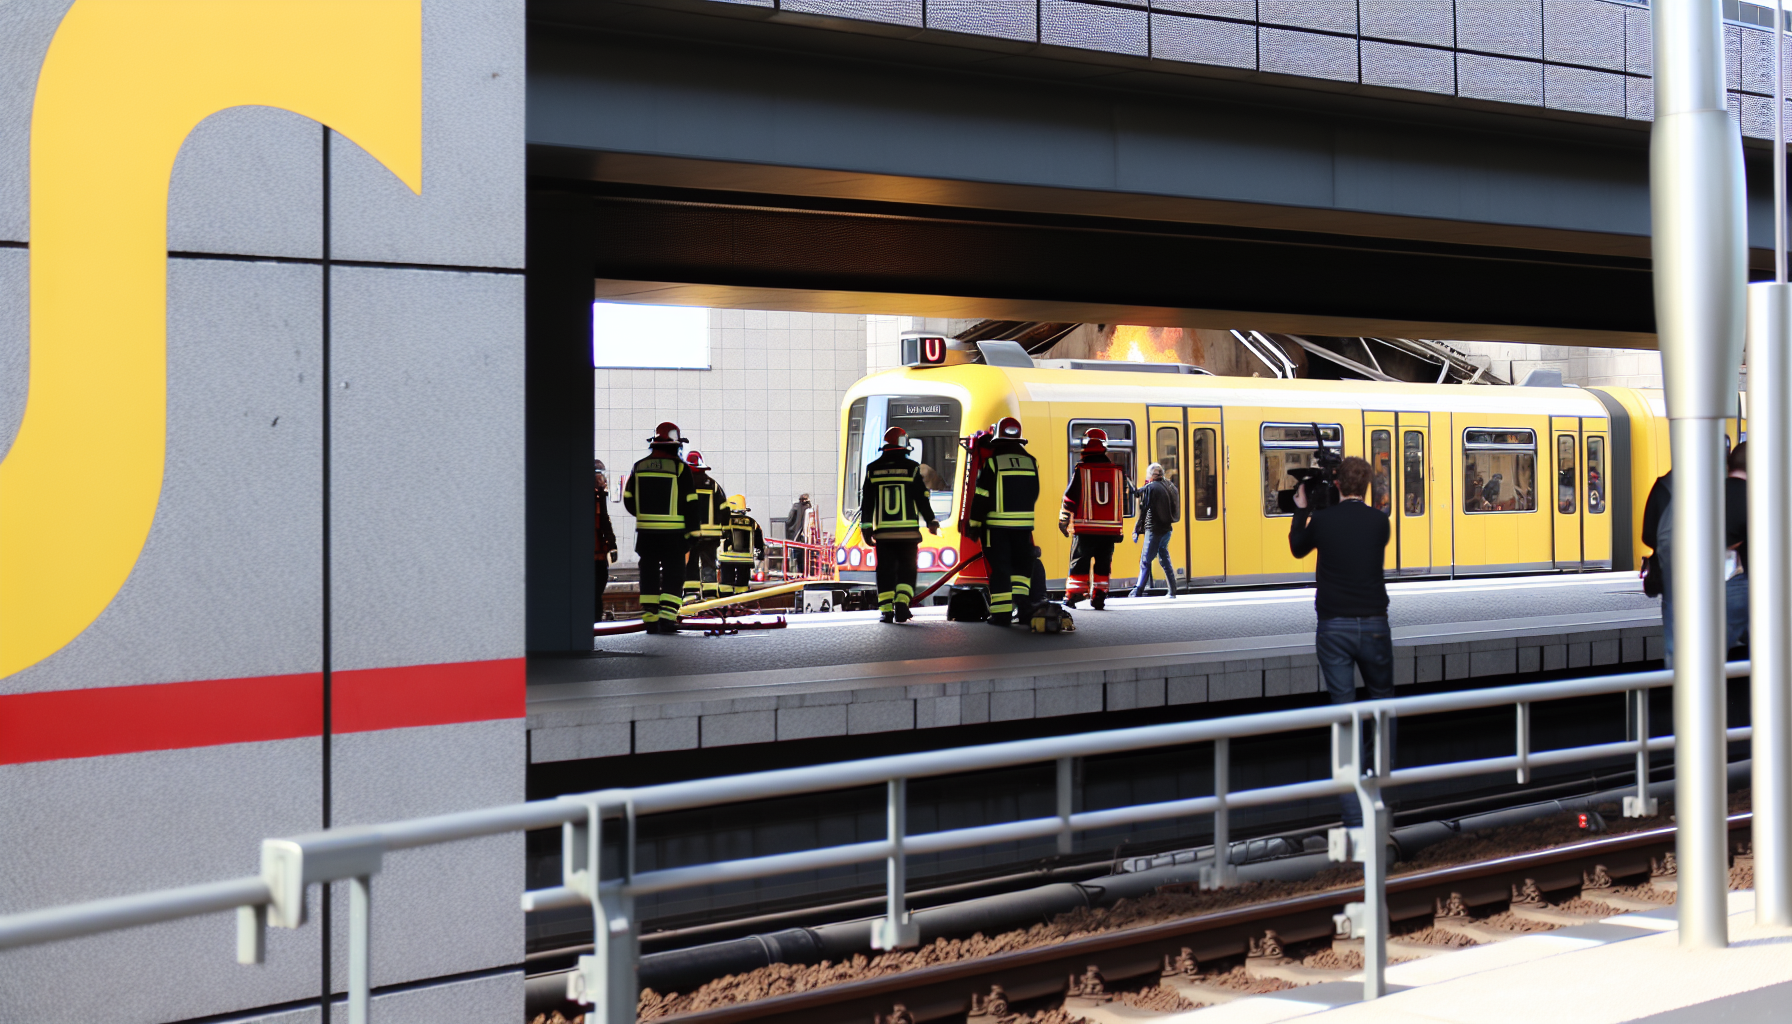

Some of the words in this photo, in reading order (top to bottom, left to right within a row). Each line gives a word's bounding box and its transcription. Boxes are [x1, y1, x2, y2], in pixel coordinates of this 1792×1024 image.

[925, 339, 940, 362] U
[884, 486, 901, 515] U
[1094, 481, 1109, 505] U
